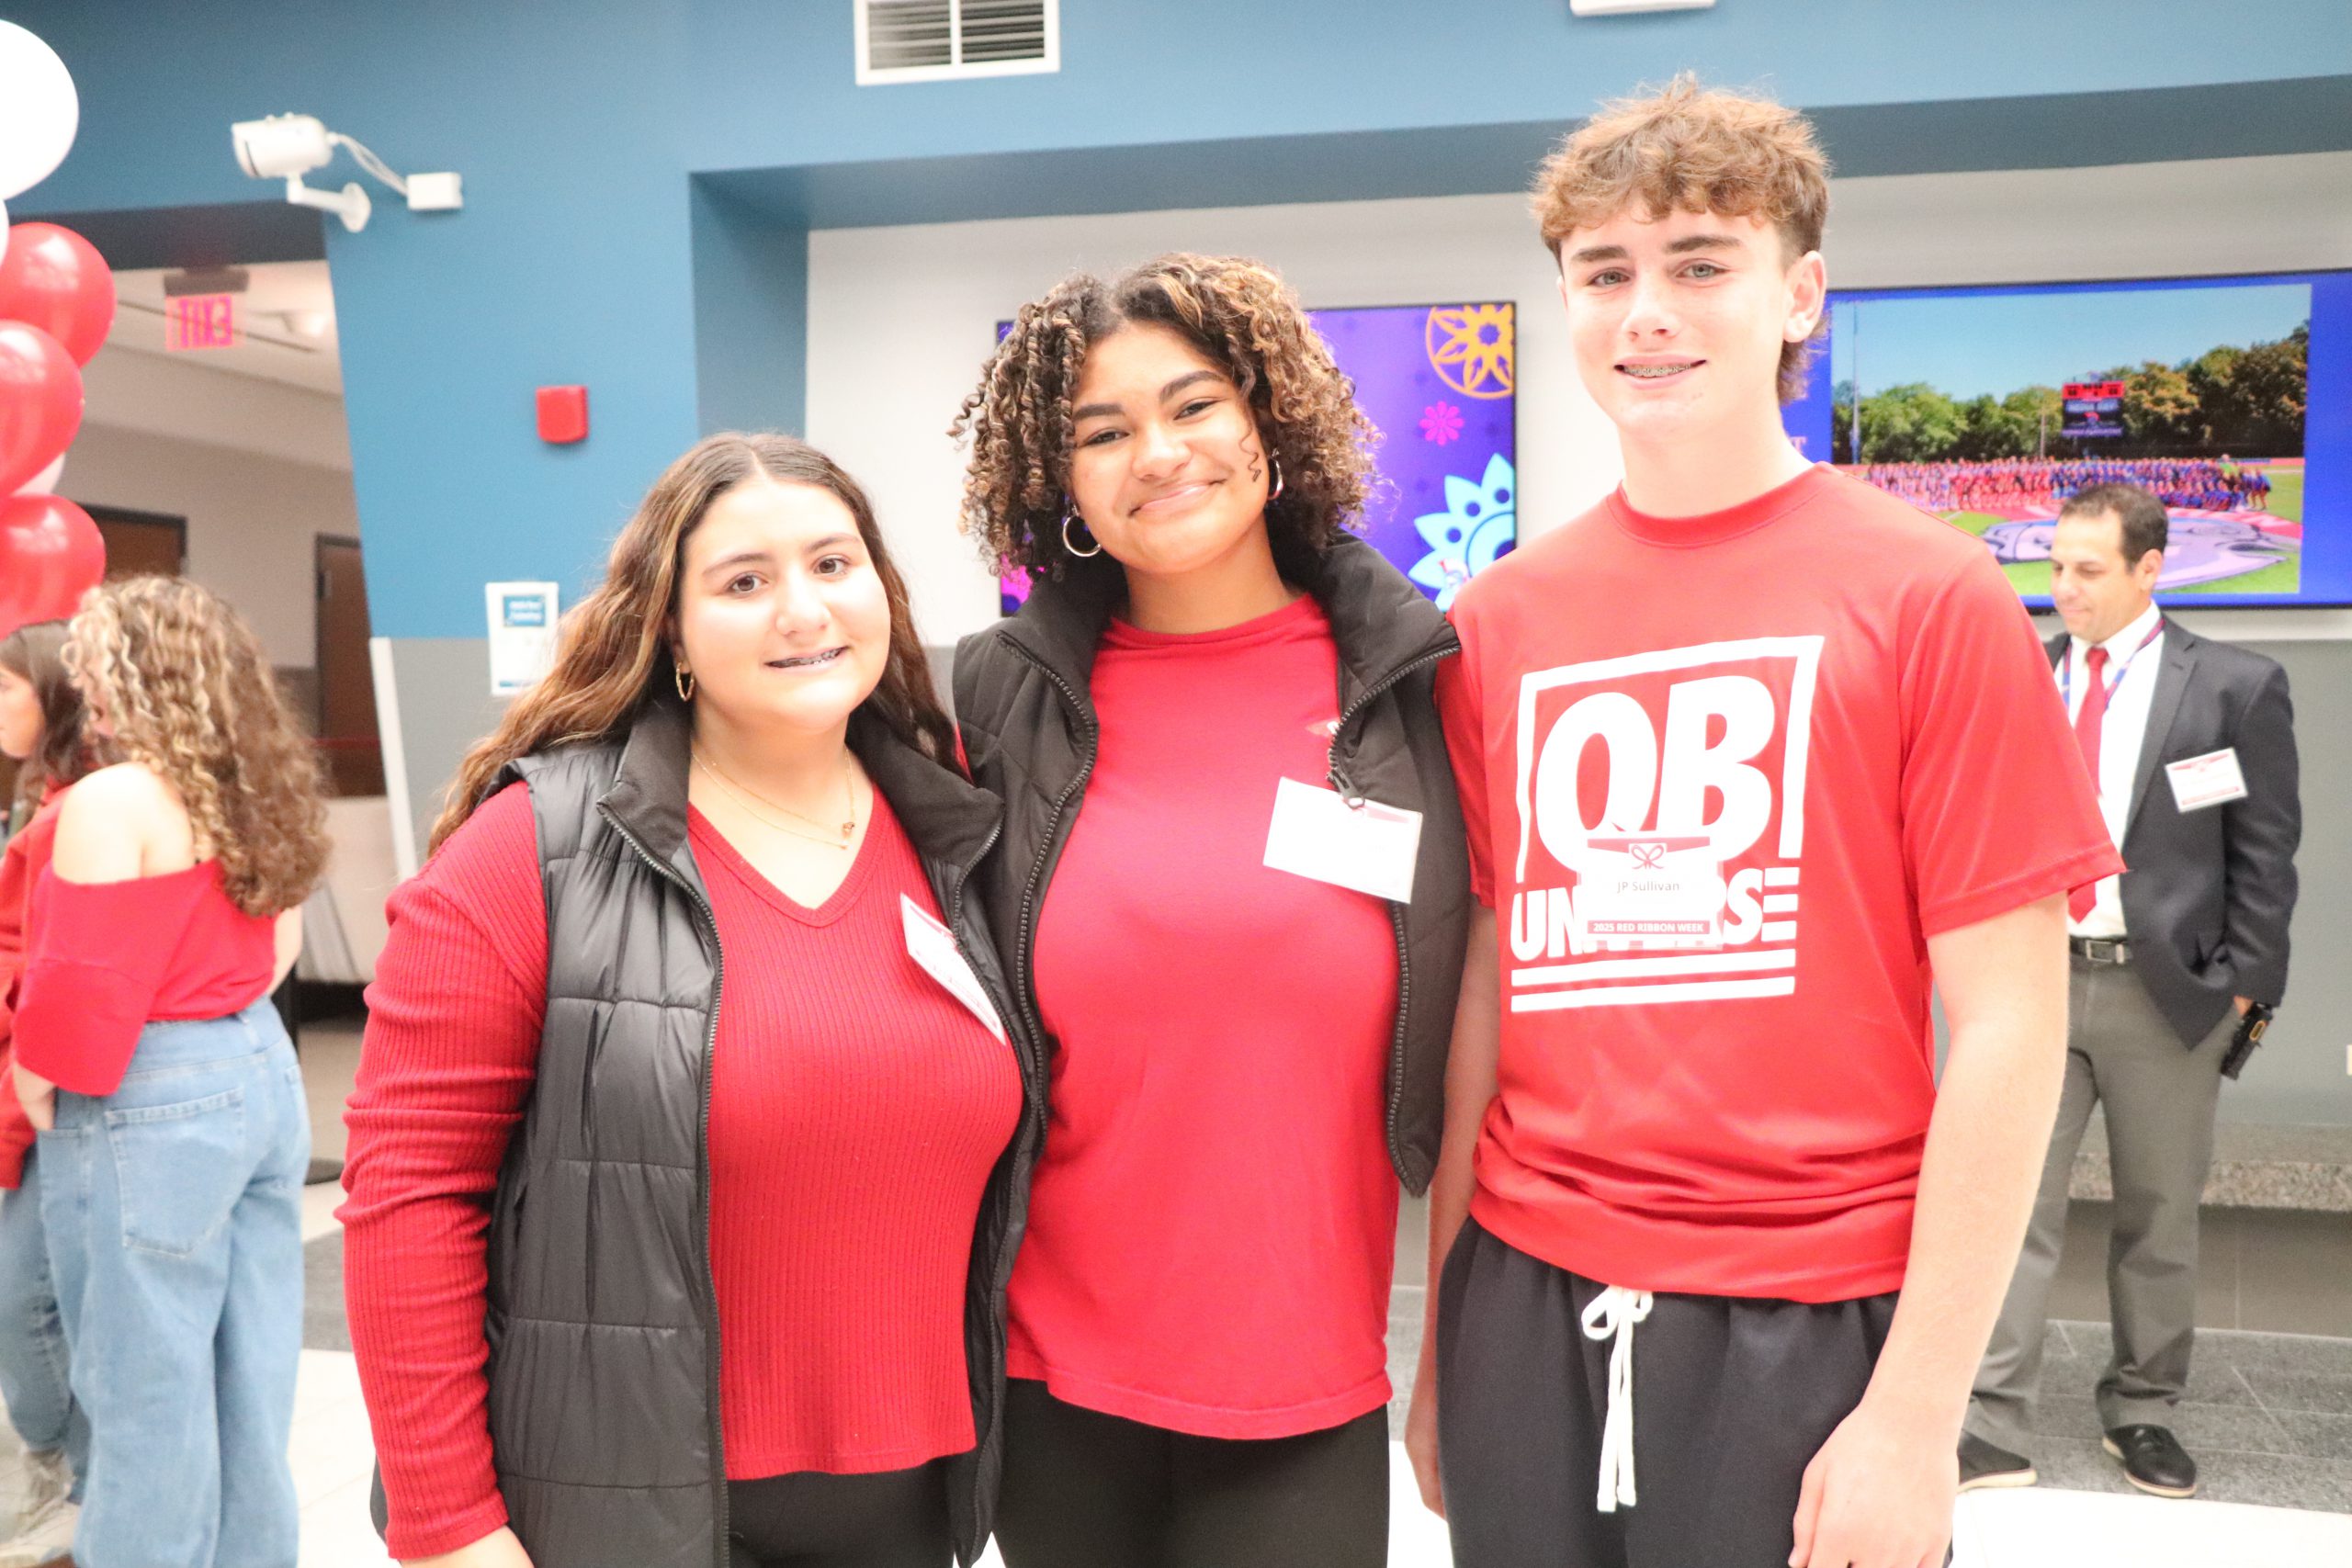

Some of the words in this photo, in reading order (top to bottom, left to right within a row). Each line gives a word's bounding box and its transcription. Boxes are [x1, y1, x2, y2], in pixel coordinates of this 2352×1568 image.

[1616, 881, 1629, 894] JP
[1632, 880, 1680, 892] Sullivan
[1510, 866, 1800, 961] UNSE
[1593, 923, 1614, 932] 2025
[1616, 923, 1635, 932] RED
[1637, 923, 1675, 932] RIBBON
[1677, 923, 1704, 932] WEEK
